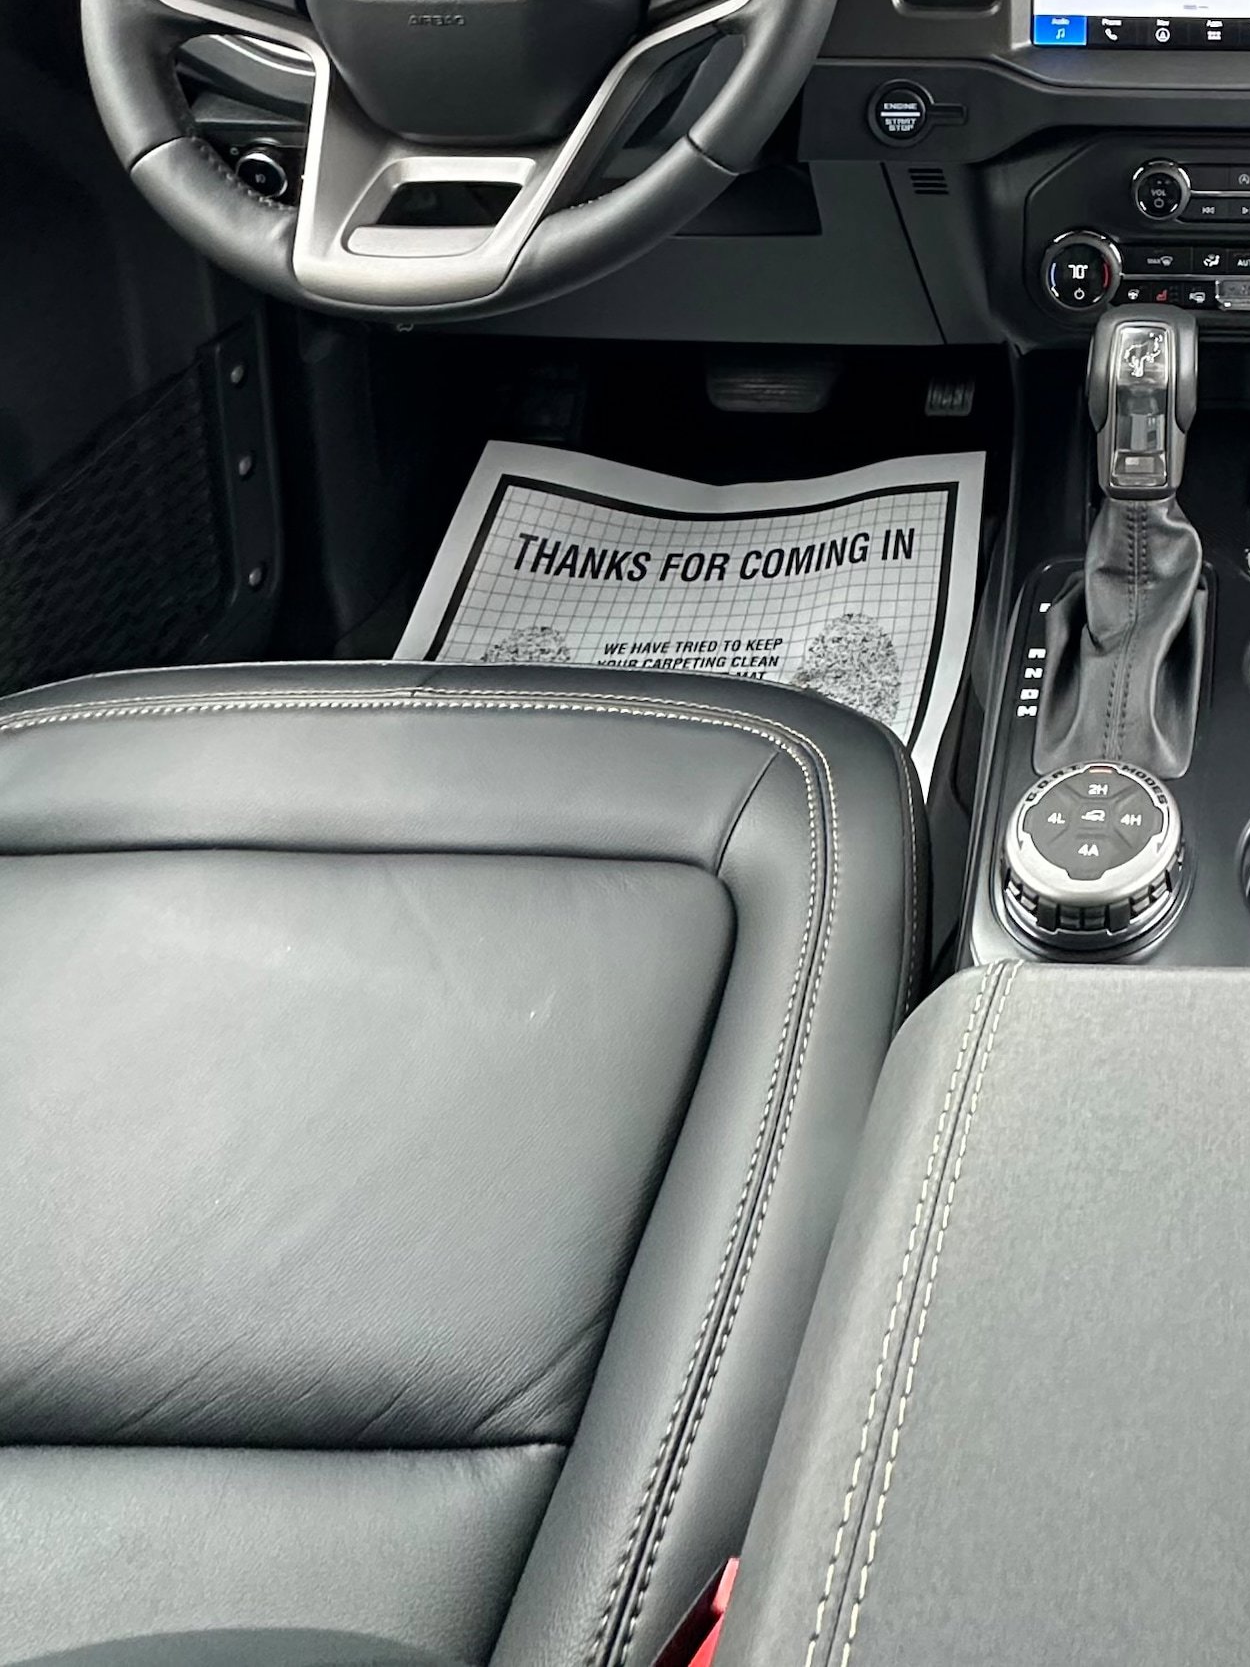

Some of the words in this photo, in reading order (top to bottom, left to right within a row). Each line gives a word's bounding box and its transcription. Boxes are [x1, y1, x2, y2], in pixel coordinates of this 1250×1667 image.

[883, 102, 918, 110] ENGINE
[888, 124, 915, 132] STOP
[1150, 189, 1167, 197] VOL
[514, 532, 651, 582] THANKS
[659, 551, 730, 583] FOR
[740, 531, 870, 580] COMING
[881, 527, 916, 561] IN
[603, 643, 628, 655] WE
[630, 641, 671, 654] HAVE
[675, 640, 718, 653] TRIED
[724, 639, 741, 652] TO
[746, 638, 783, 651] KEEP
[641, 657, 728, 670] CARPETING
[731, 656, 780, 669] CLEAN
[1024, 667, 1043, 679] N
[1020, 688, 1040, 700] D
[1016, 705, 1038, 717] M
[1088, 784, 1109, 796] 2H
[1121, 764, 1169, 806] MODES
[1047, 812, 1066, 824] 4L
[1120, 813, 1142, 826] 4H
[1077, 844, 1100, 857] 4A
